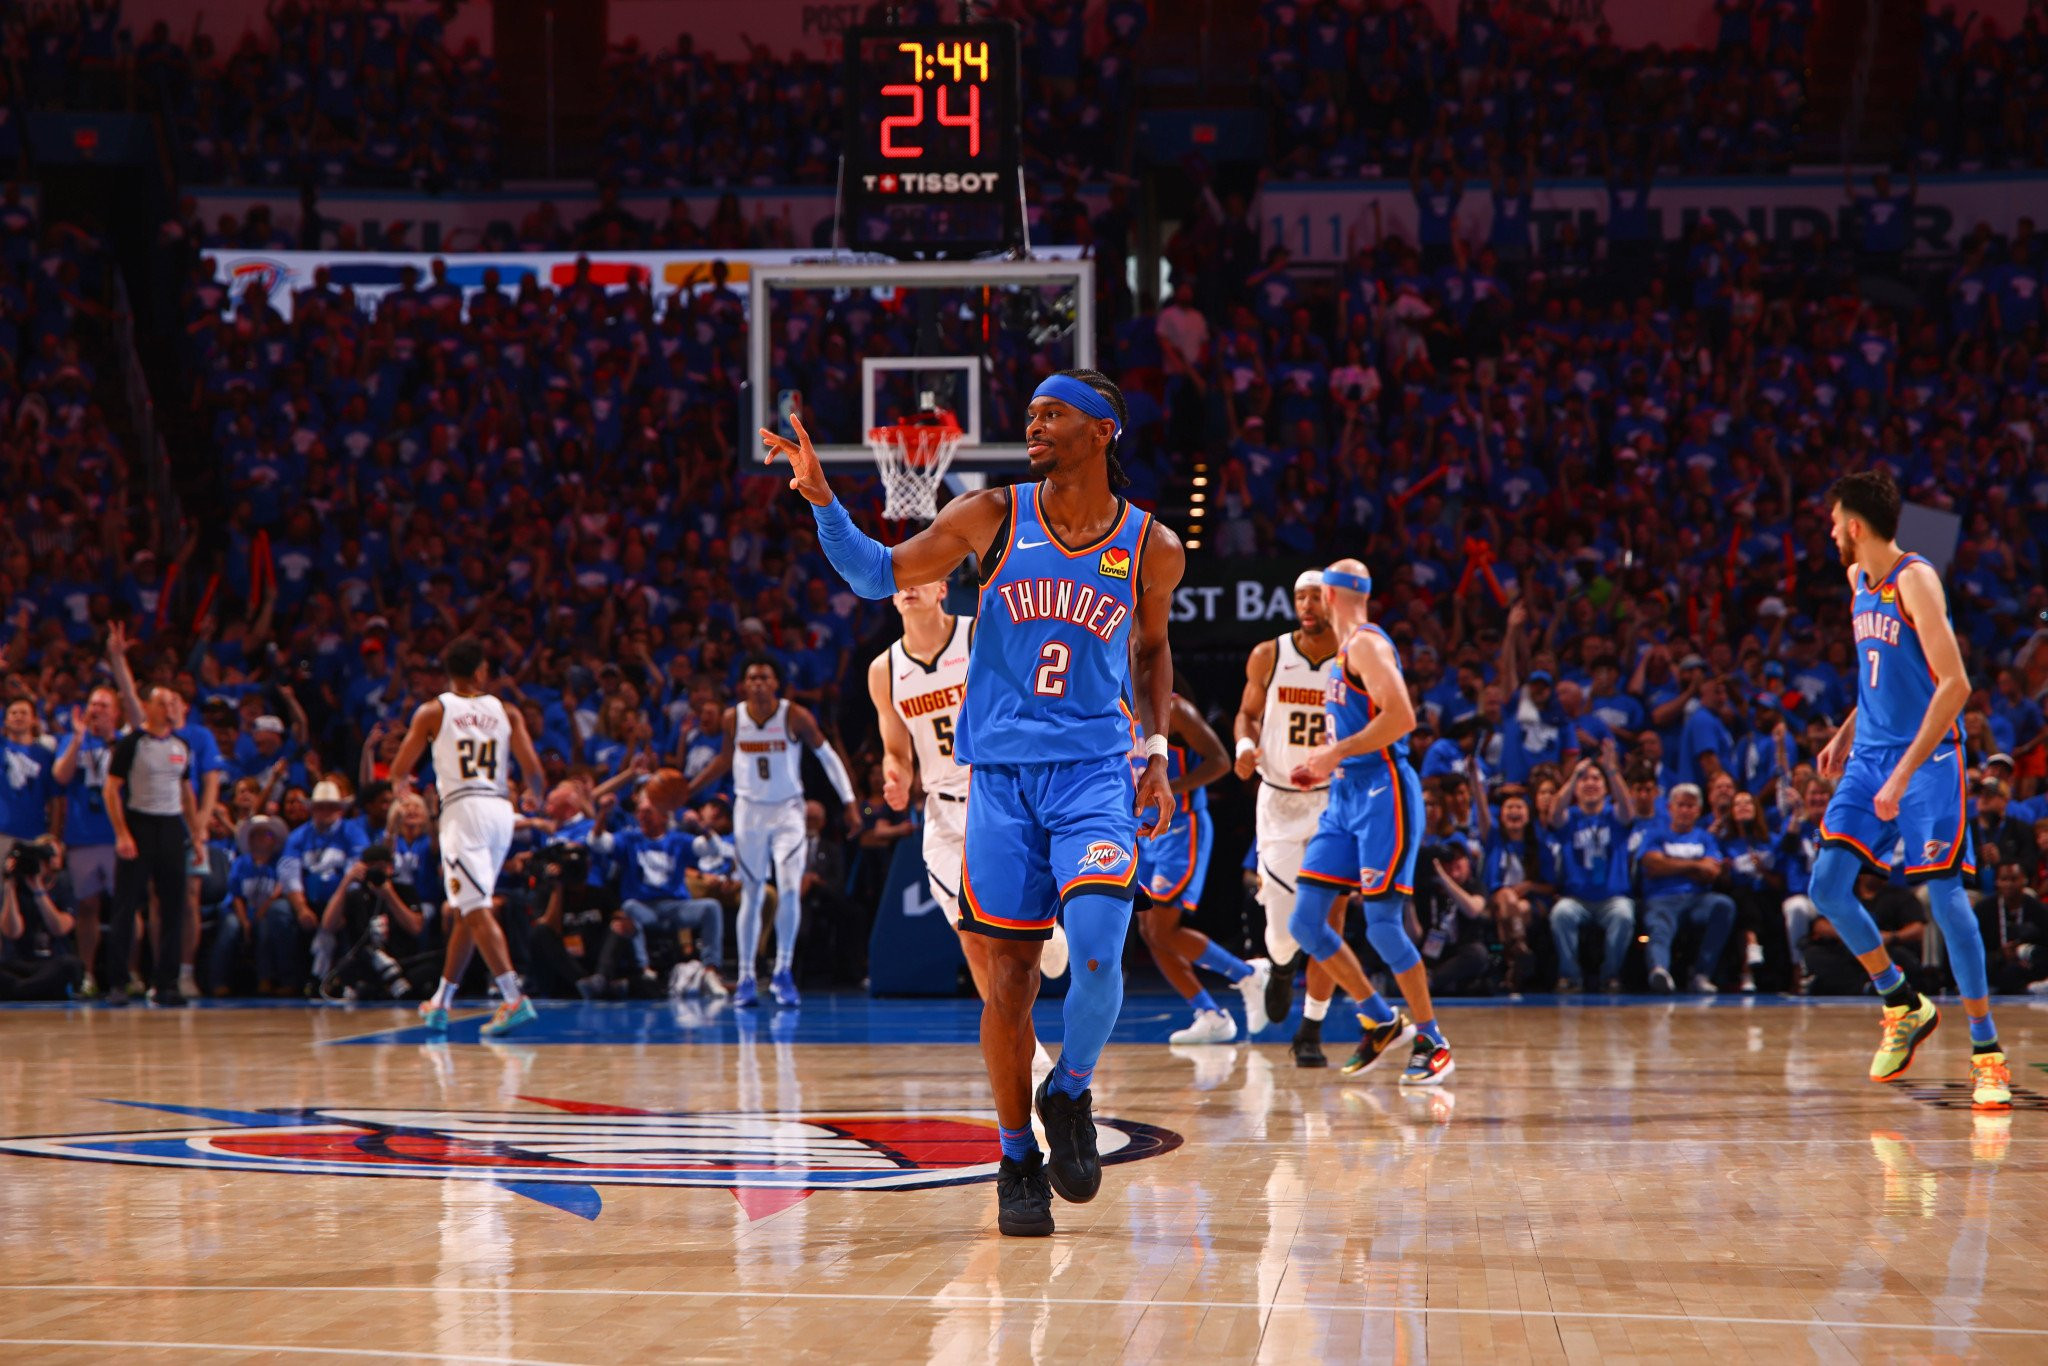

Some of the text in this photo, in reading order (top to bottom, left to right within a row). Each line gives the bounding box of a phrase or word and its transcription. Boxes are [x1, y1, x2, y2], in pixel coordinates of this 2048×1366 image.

[898, 41, 989, 83] 7:44
[880, 83, 981, 159] 24
[899, 171, 1000, 195] TISSOT
[998, 578, 1129, 643] THUNDER
[1236, 580, 1297, 621] BA
[1034, 640, 1073, 698] 2
[1867, 649, 1880, 689] 7
[1290, 711, 1326, 747] 22
[458, 739, 497, 779] 24
